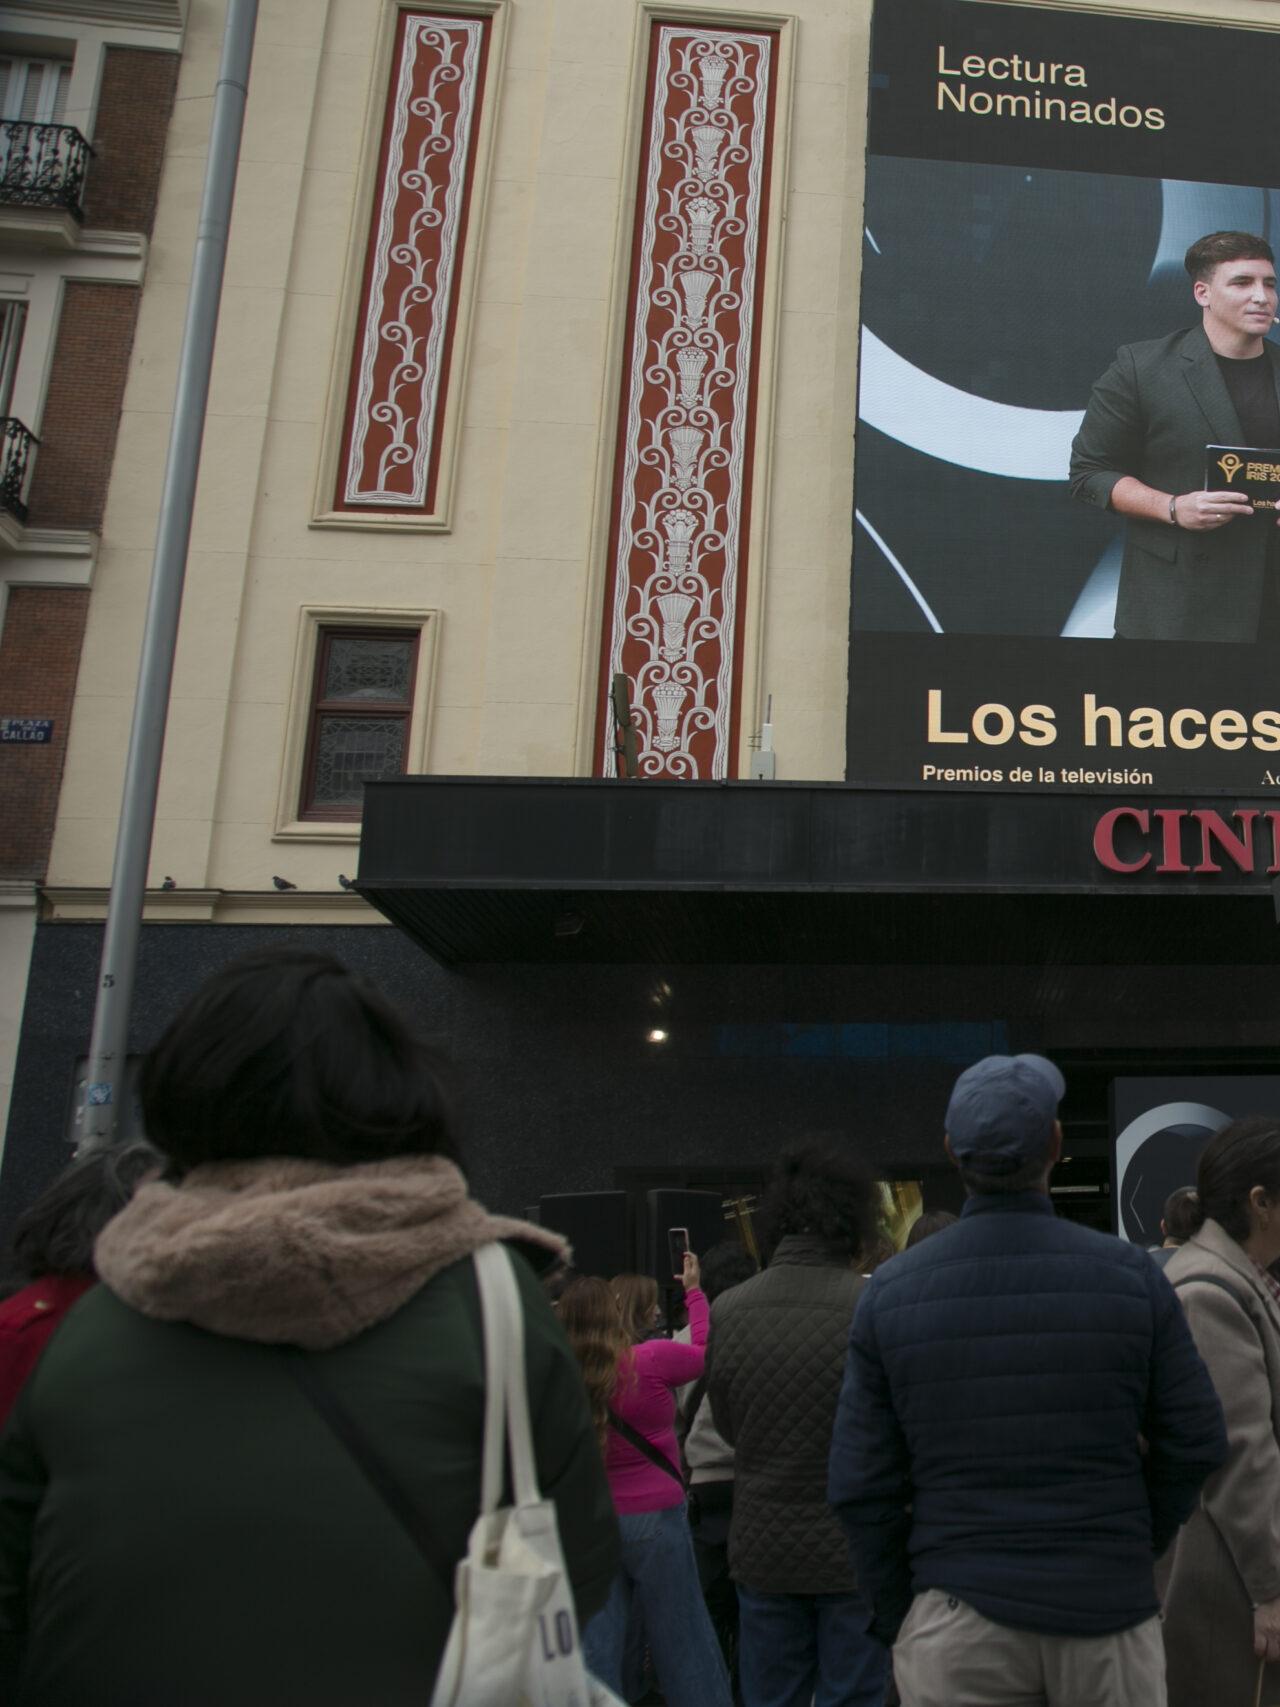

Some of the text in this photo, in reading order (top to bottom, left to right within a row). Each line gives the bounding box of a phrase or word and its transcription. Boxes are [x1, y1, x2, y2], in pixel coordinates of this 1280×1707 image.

[938, 45, 1088, 87] Lectura
[937, 81, 1166, 130] Nominados
[1246, 471, 1268, 481] IRIS
[927, 689, 1058, 746] Los
[2, 730, 45, 741] CALLAO
[922, 764, 1154, 785] Premios de la televisión
